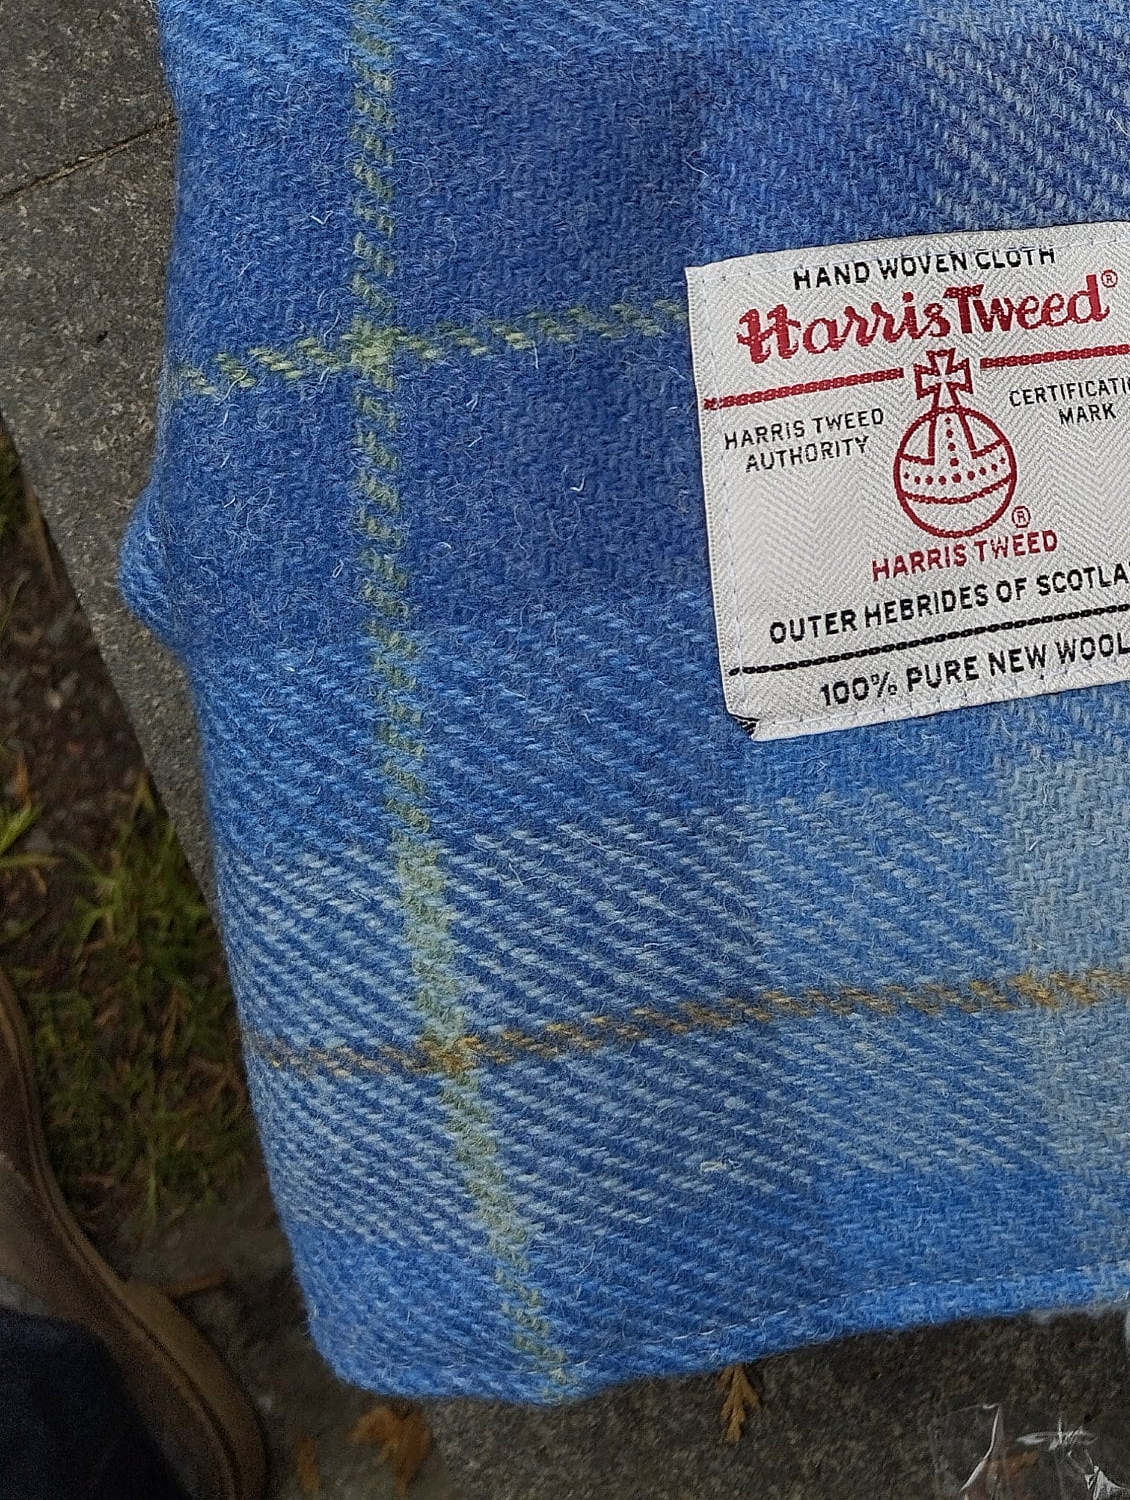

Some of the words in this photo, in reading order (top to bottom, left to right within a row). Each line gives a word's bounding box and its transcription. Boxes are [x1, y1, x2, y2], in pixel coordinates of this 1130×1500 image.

[793, 260, 870, 291] HAND
[879, 250, 969, 281] WOVEN
[978, 245, 1056, 270] CLOTH
[723, 419, 805, 450] HARRIS
[812, 408, 885, 440] TWEED
[1059, 403, 1117, 426] MARK
[745, 436, 870, 473] AUTHORITY
[871, 545, 967, 582] HARRIS
[973, 529, 1058, 562] TWEED
[769, 609, 857, 644] OUTER
[865, 585, 989, 630] HEBRIDES
[996, 577, 1028, 602] OF
[820, 670, 899, 707] 100%
[906, 660, 978, 694] PURE
[988, 645, 1047, 676] NEW
[1057, 633, 1130, 664] WOOL
